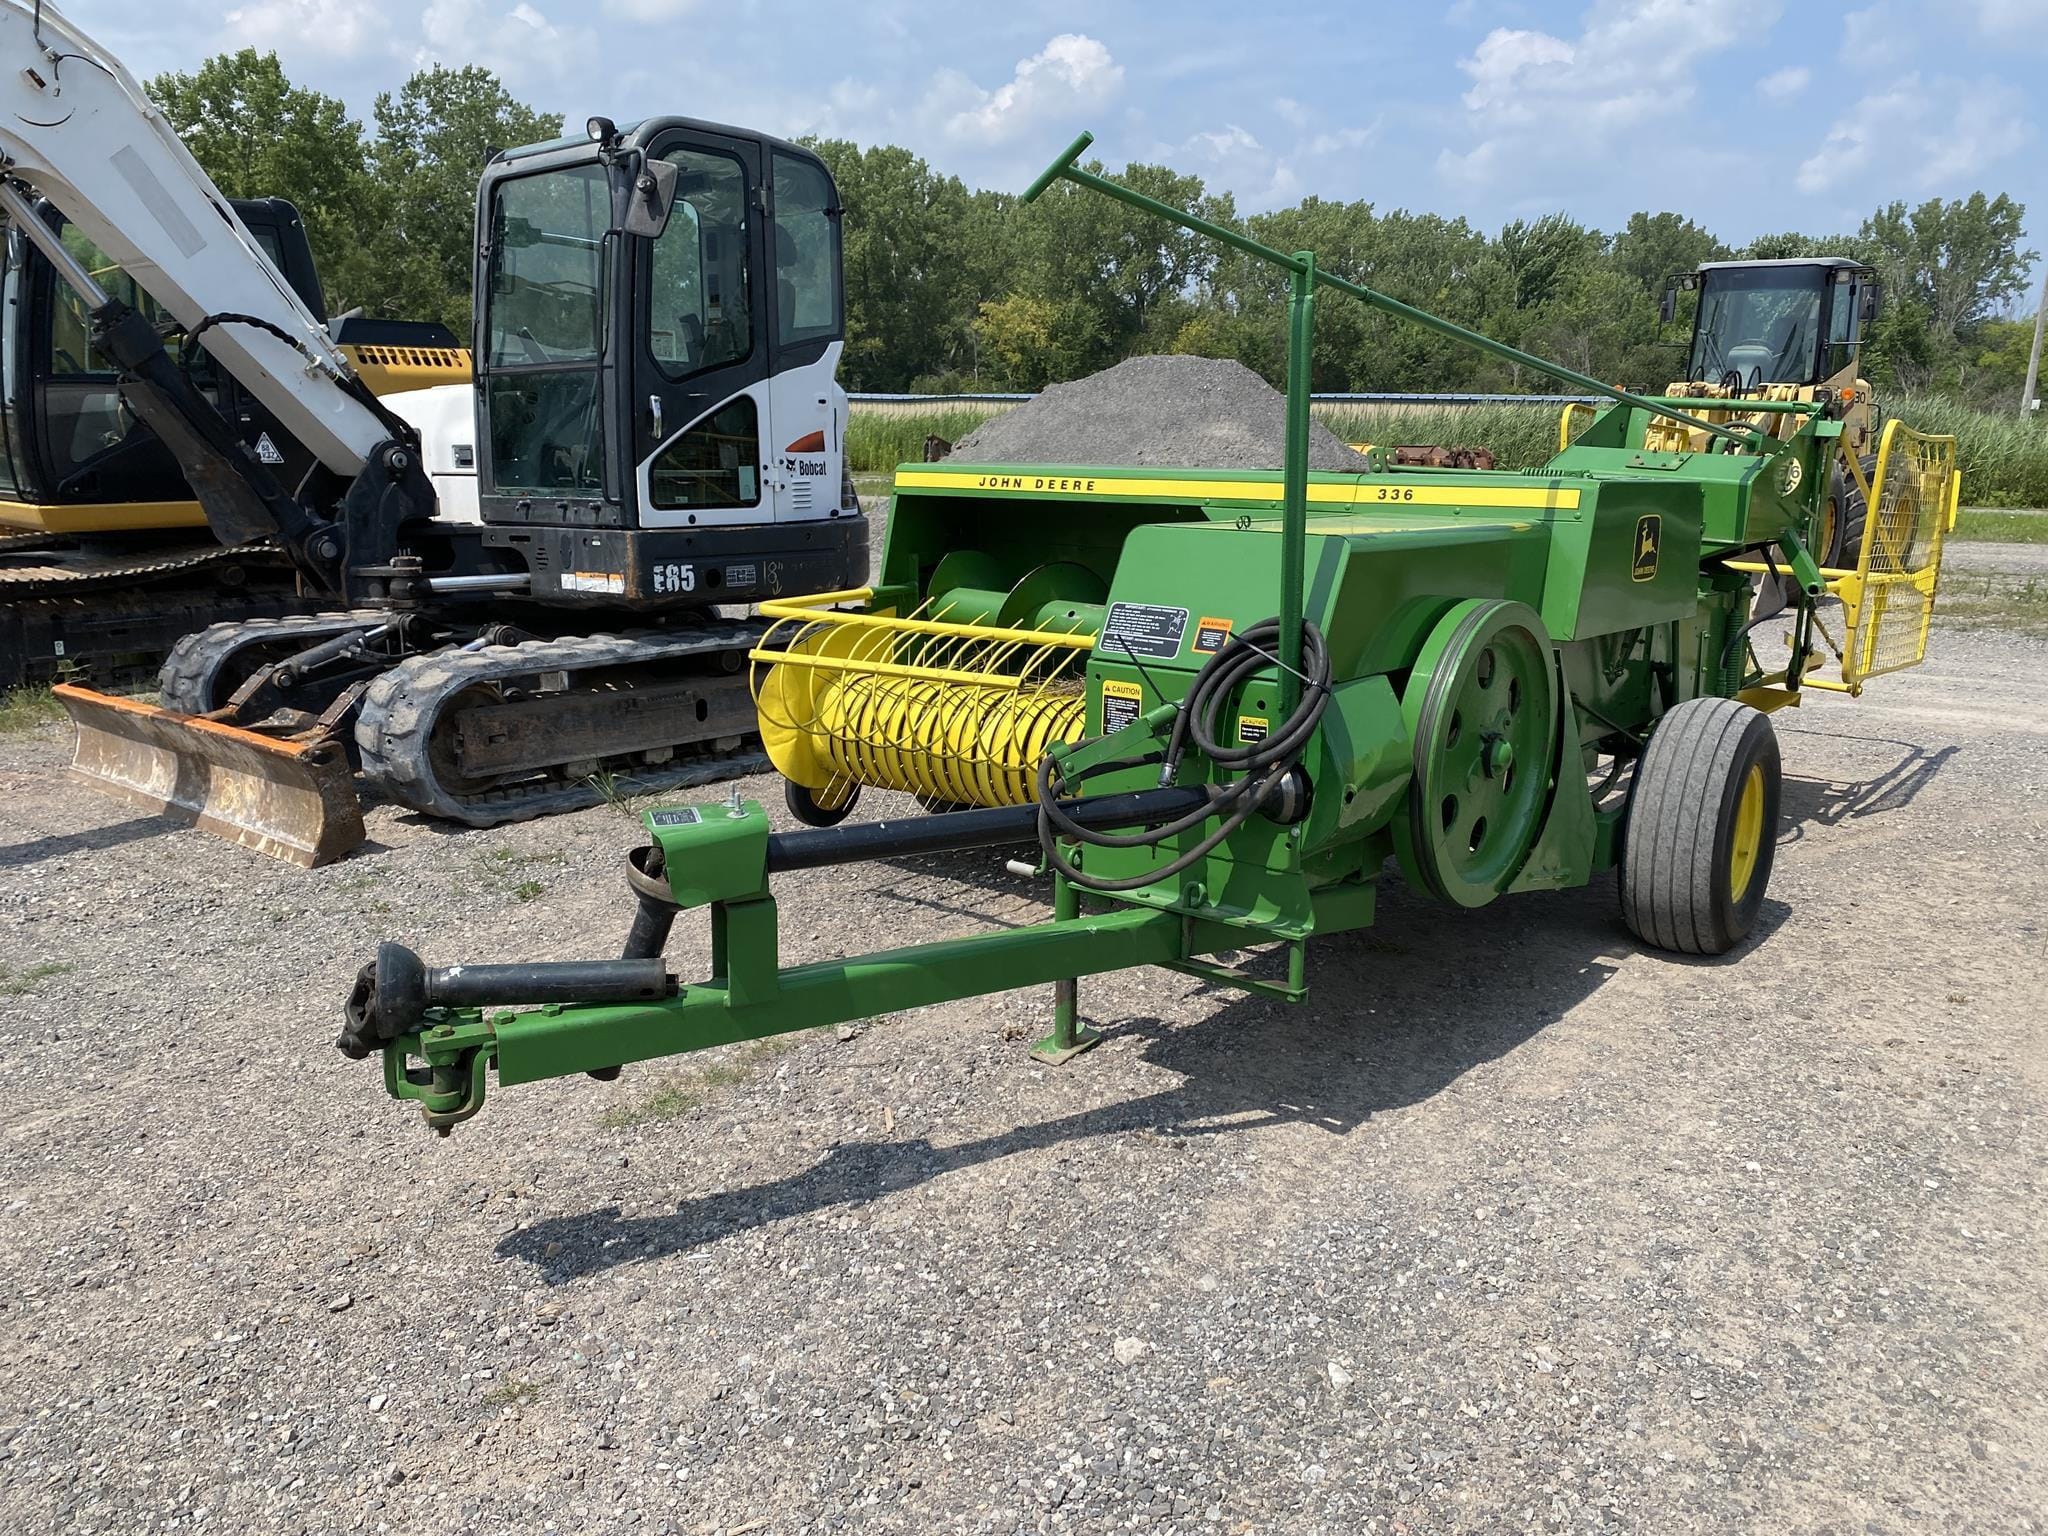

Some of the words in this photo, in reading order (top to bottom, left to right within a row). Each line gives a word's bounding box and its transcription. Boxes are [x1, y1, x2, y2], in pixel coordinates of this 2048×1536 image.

[799, 460, 827, 476] Bobcat
[979, 476, 1022, 488] JOHN
[1035, 479, 1095, 491] DEERE
[1377, 488, 1413, 501] 336
[653, 564, 695, 593] E85
[1112, 685, 1140, 696] CAUTION
